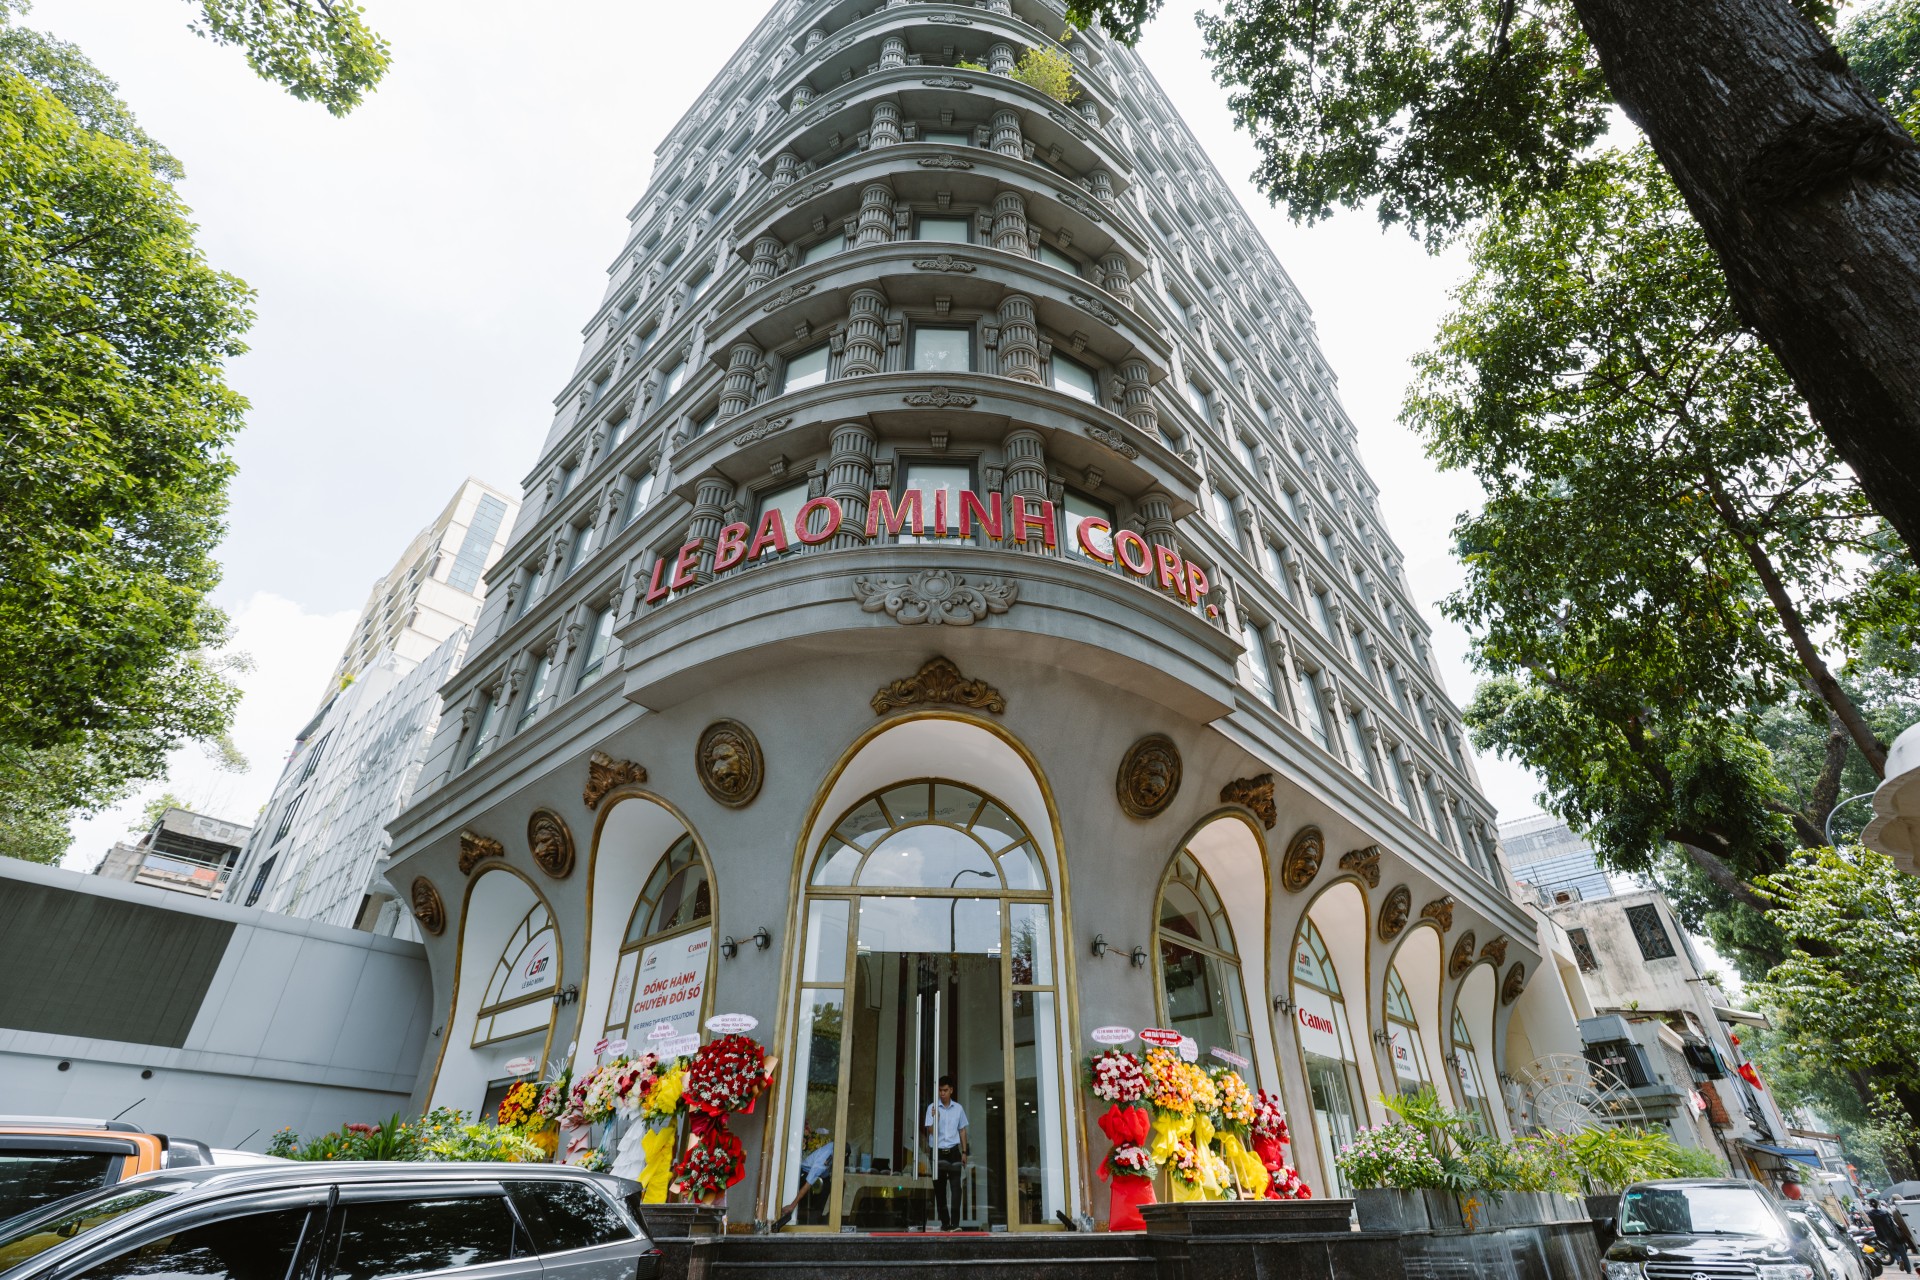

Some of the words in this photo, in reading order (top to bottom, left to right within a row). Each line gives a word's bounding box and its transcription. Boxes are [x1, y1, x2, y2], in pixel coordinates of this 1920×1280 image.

[646, 538, 704, 604] LE
[714, 496, 843, 574] BAO
[865, 488, 1056, 550] MINH
[1076, 516, 1219, 619] CORP.
[687, 941, 708, 953] Canon
[687, 981, 702, 1000] SỐ
[671, 1010, 695, 1021] SOLUTIONS
[1299, 1007, 1333, 1034] Canon
